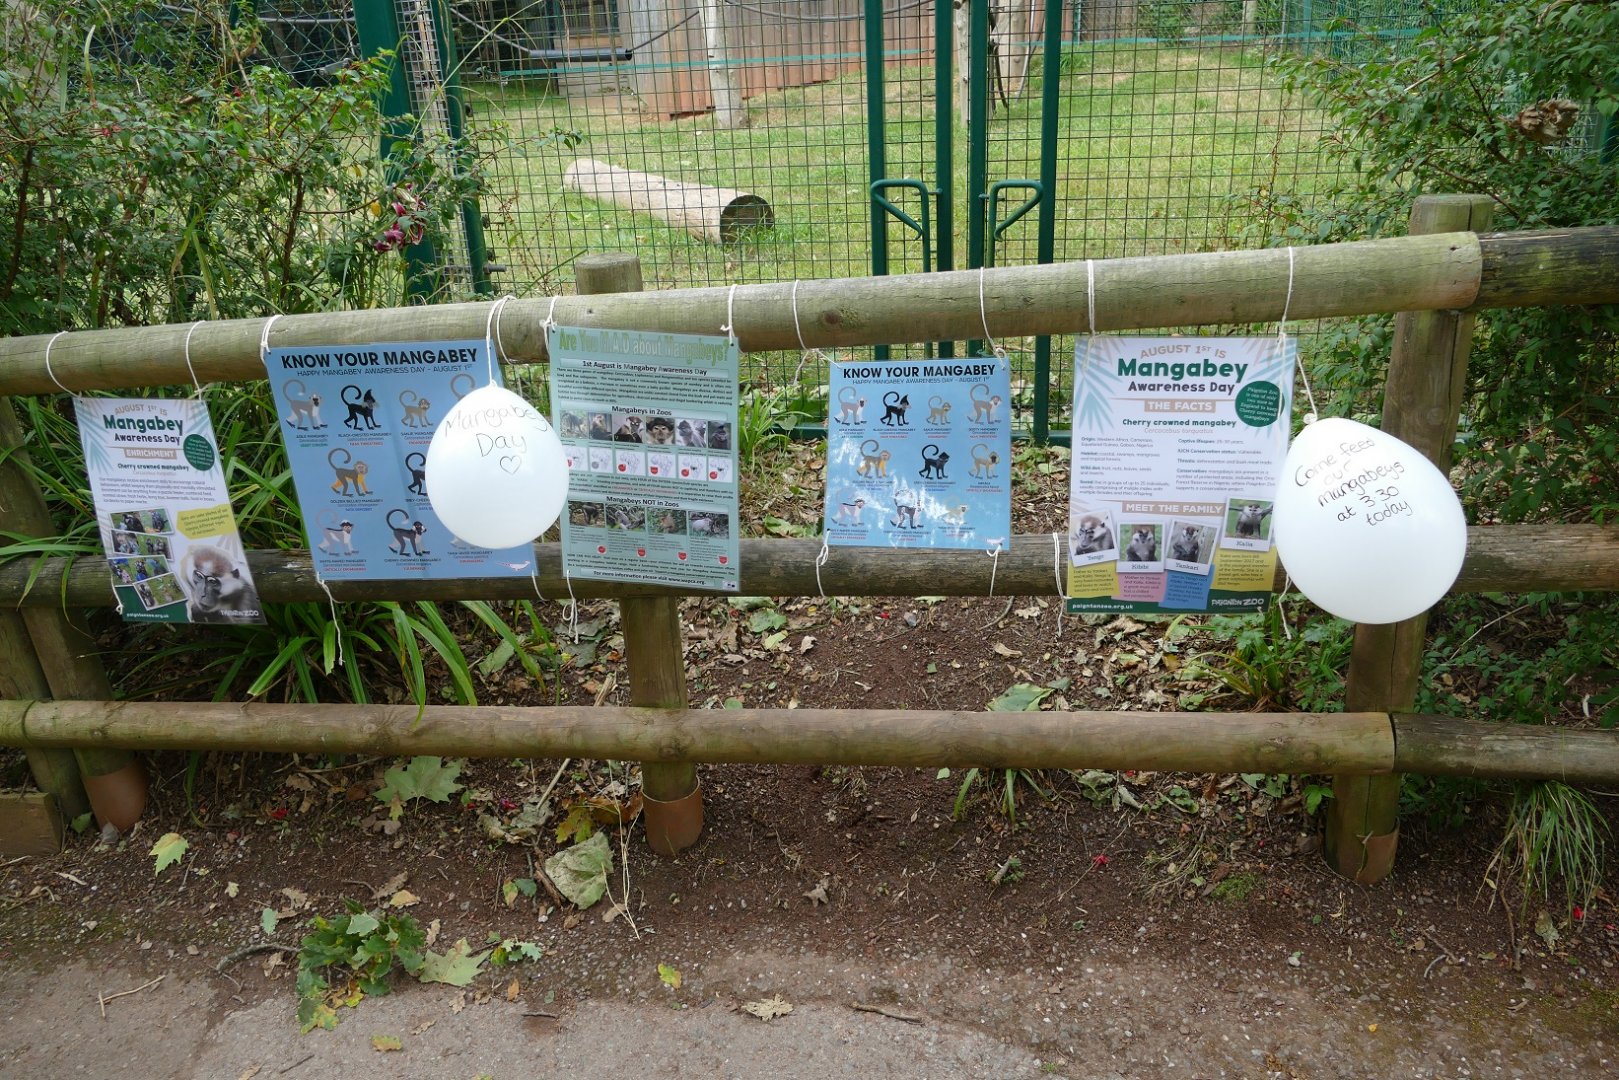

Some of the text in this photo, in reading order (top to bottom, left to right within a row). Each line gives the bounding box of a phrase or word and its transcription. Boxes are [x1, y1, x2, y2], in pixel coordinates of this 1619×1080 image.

[559, 329, 577, 351] Are
[579, 330, 598, 352] You
[633, 335, 661, 356] about
[664, 336, 728, 367] Mangabeys?
[1140, 345, 1226, 359] AUGUST 1ST IS
[282, 348, 477, 369] KNOW YOUR MANGABEY
[594, 361, 615, 369] August
[624, 364, 657, 372] Mangabey
[844, 364, 995, 378] KNOW YOUR MANGABEY
[1118, 359, 1248, 383] Mangabey
[1128, 382, 1235, 396] Awareness Day
[115, 404, 144, 414] AUGUST
[160, 408, 167, 416] IS
[612, 406, 647, 414] Mangabeys
[1148, 401, 1212, 411] THE FACTS
[103, 414, 183, 436] Mangabey
[445, 404, 547, 438] Mangabey
[1123, 419, 1151, 427] Cherry
[1192, 419, 1236, 428] mangabey
[115, 433, 180, 445] Awareness Day
[476, 433, 527, 457] Day
[126, 449, 175, 458] ENRICHMENT
[1295, 438, 1375, 486] Come feed
[1324, 460, 1351, 486] our
[606, 496, 641, 505] Mangabeys
[1183, 505, 1222, 513] FAMILY
[1338, 506, 1356, 521] at
[1366, 500, 1413, 526] today
